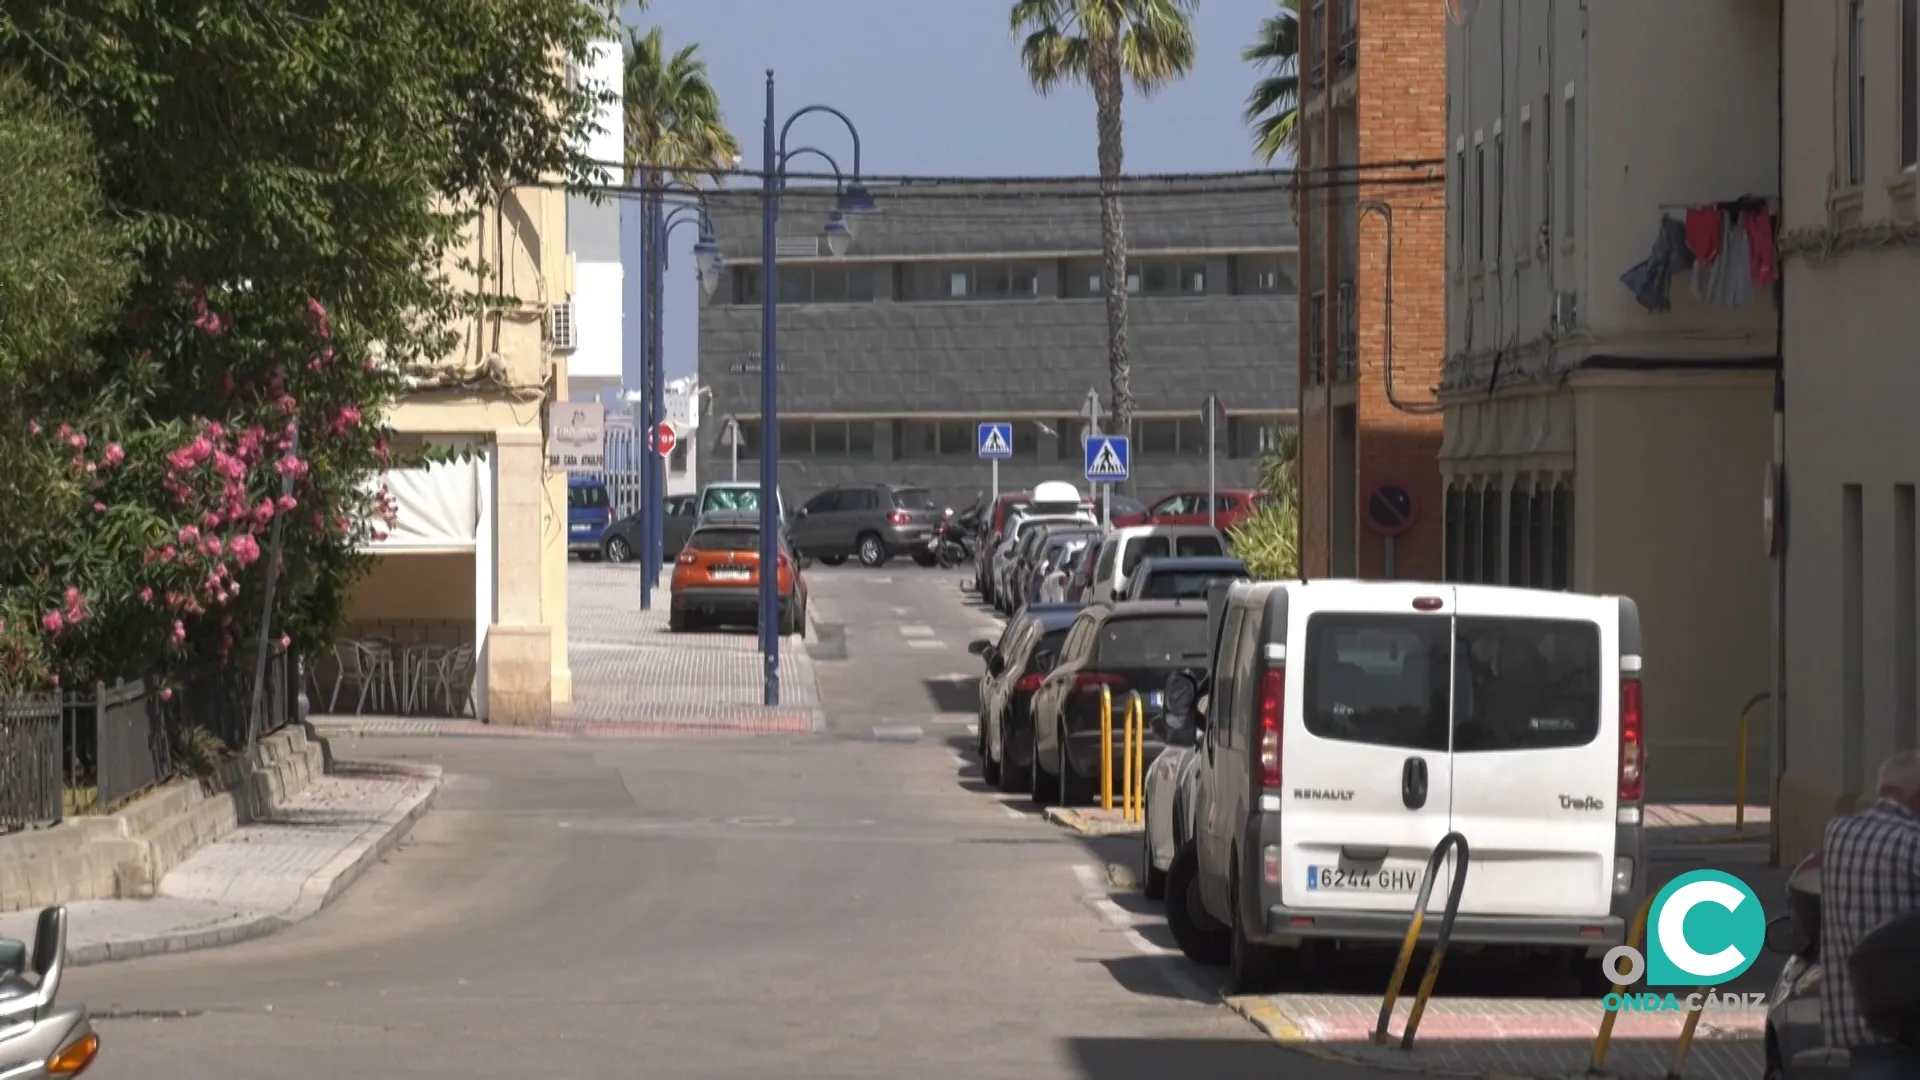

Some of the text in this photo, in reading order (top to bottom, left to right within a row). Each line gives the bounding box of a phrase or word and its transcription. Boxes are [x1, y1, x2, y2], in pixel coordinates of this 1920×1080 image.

[1293, 787, 1355, 801] RENAULT
[1321, 868, 1417, 891] 6244 GHV
